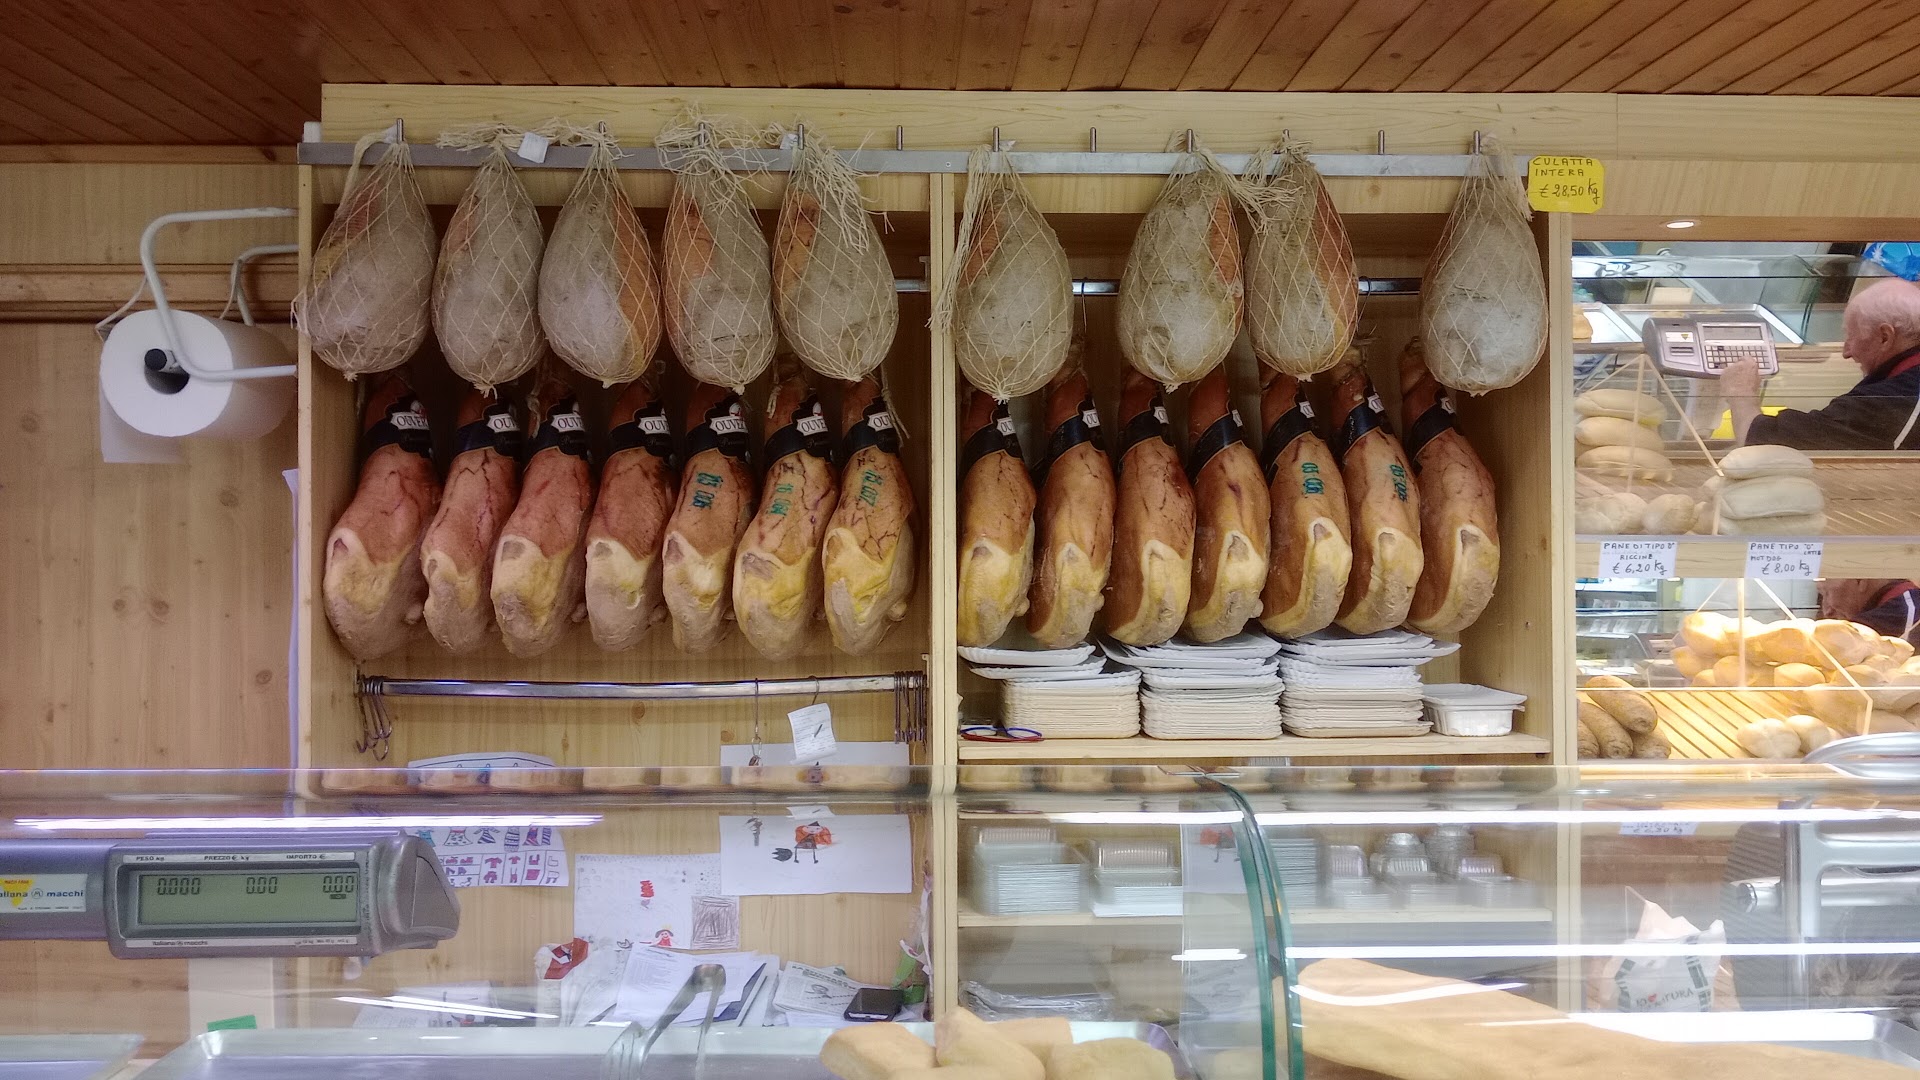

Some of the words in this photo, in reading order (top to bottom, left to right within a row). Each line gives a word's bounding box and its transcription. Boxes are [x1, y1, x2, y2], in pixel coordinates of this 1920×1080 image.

[1533, 157, 1593, 166] CULATTA
[1535, 168, 1584, 177] INTERA
[1552, 183, 1584, 198] 28,50
[1625, 563, 1650, 574] 6,20
[157, 878, 200, 895] 0.000
[246, 877, 278, 894] 0.00
[323, 875, 354, 893] 0.00
